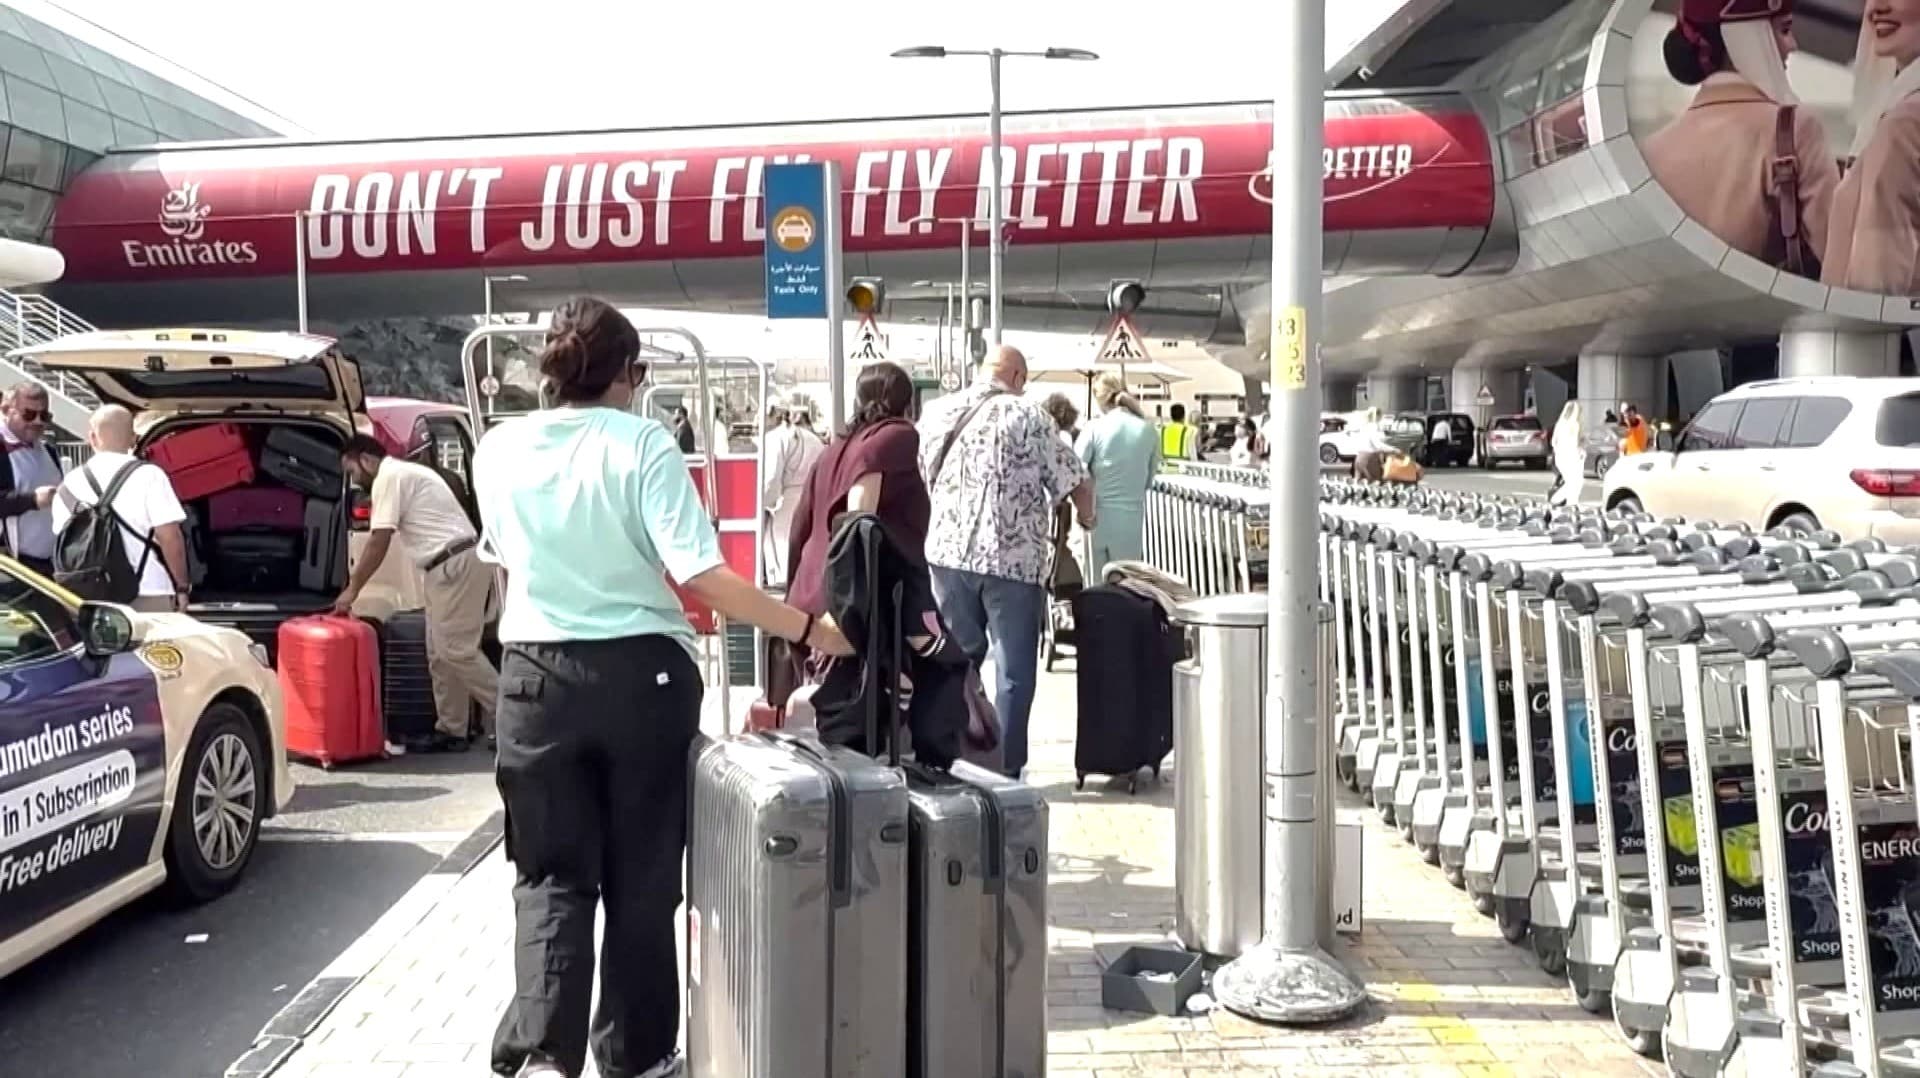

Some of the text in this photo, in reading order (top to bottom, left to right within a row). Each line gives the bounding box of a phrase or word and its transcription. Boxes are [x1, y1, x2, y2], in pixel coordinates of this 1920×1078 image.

[309, 168, 502, 259] DON'T
[521, 160, 687, 251] JUST
[709, 154, 811, 242] FL
[974, 137, 1204, 230] BETTER
[121, 238, 257, 267] Emirates
[774, 285, 818, 295] Taxis Only
[80, 703, 133, 748] series
[3, 765, 129, 837] in 1 Subscription
[0, 815, 124, 891] Free delivery
[1801, 940, 1840, 956] Shop
